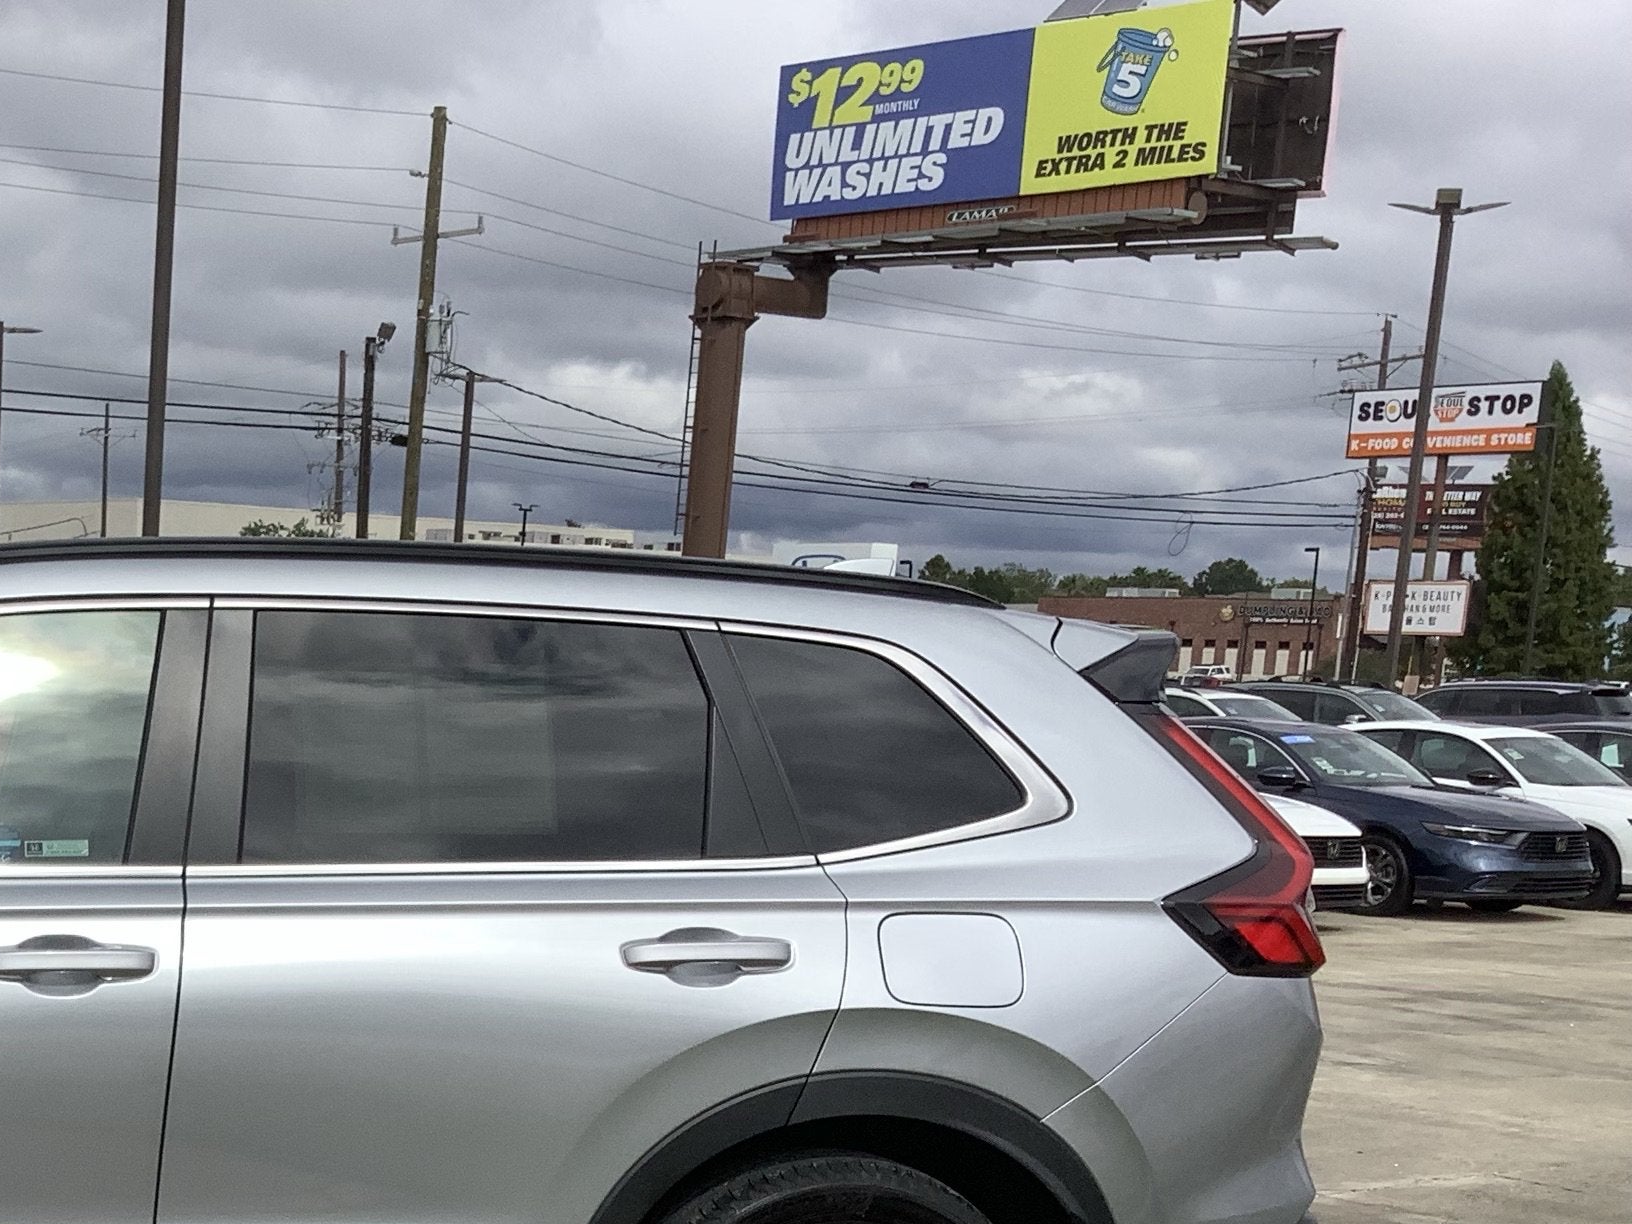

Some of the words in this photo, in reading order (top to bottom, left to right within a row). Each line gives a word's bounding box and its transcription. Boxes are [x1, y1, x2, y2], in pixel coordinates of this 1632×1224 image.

[1120, 51, 1153, 66] TAKE
[1112, 63, 1148, 99] 5
[875, 98, 920, 115] MONTHLY
[785, 106, 1005, 169] UNLIMITED
[1057, 126, 1139, 154] WORTH
[1144, 121, 1188, 143] THE
[1035, 152, 1106, 178] EXTRA
[1112, 150, 1129, 169] 2
[1134, 142, 1208, 167] MILES
[784, 152, 948, 207] WASHES
[1358, 398, 1418, 422] SEOU
[1466, 393, 1533, 417] STOP
[1437, 408, 1460, 419] STOP
[1351, 436, 1398, 451] K-FOOD
[1402, 433, 1487, 449] CVENIENCE
[1490, 432, 1532, 446] STORE
[1238, 605, 1296, 617] DUMPLING
